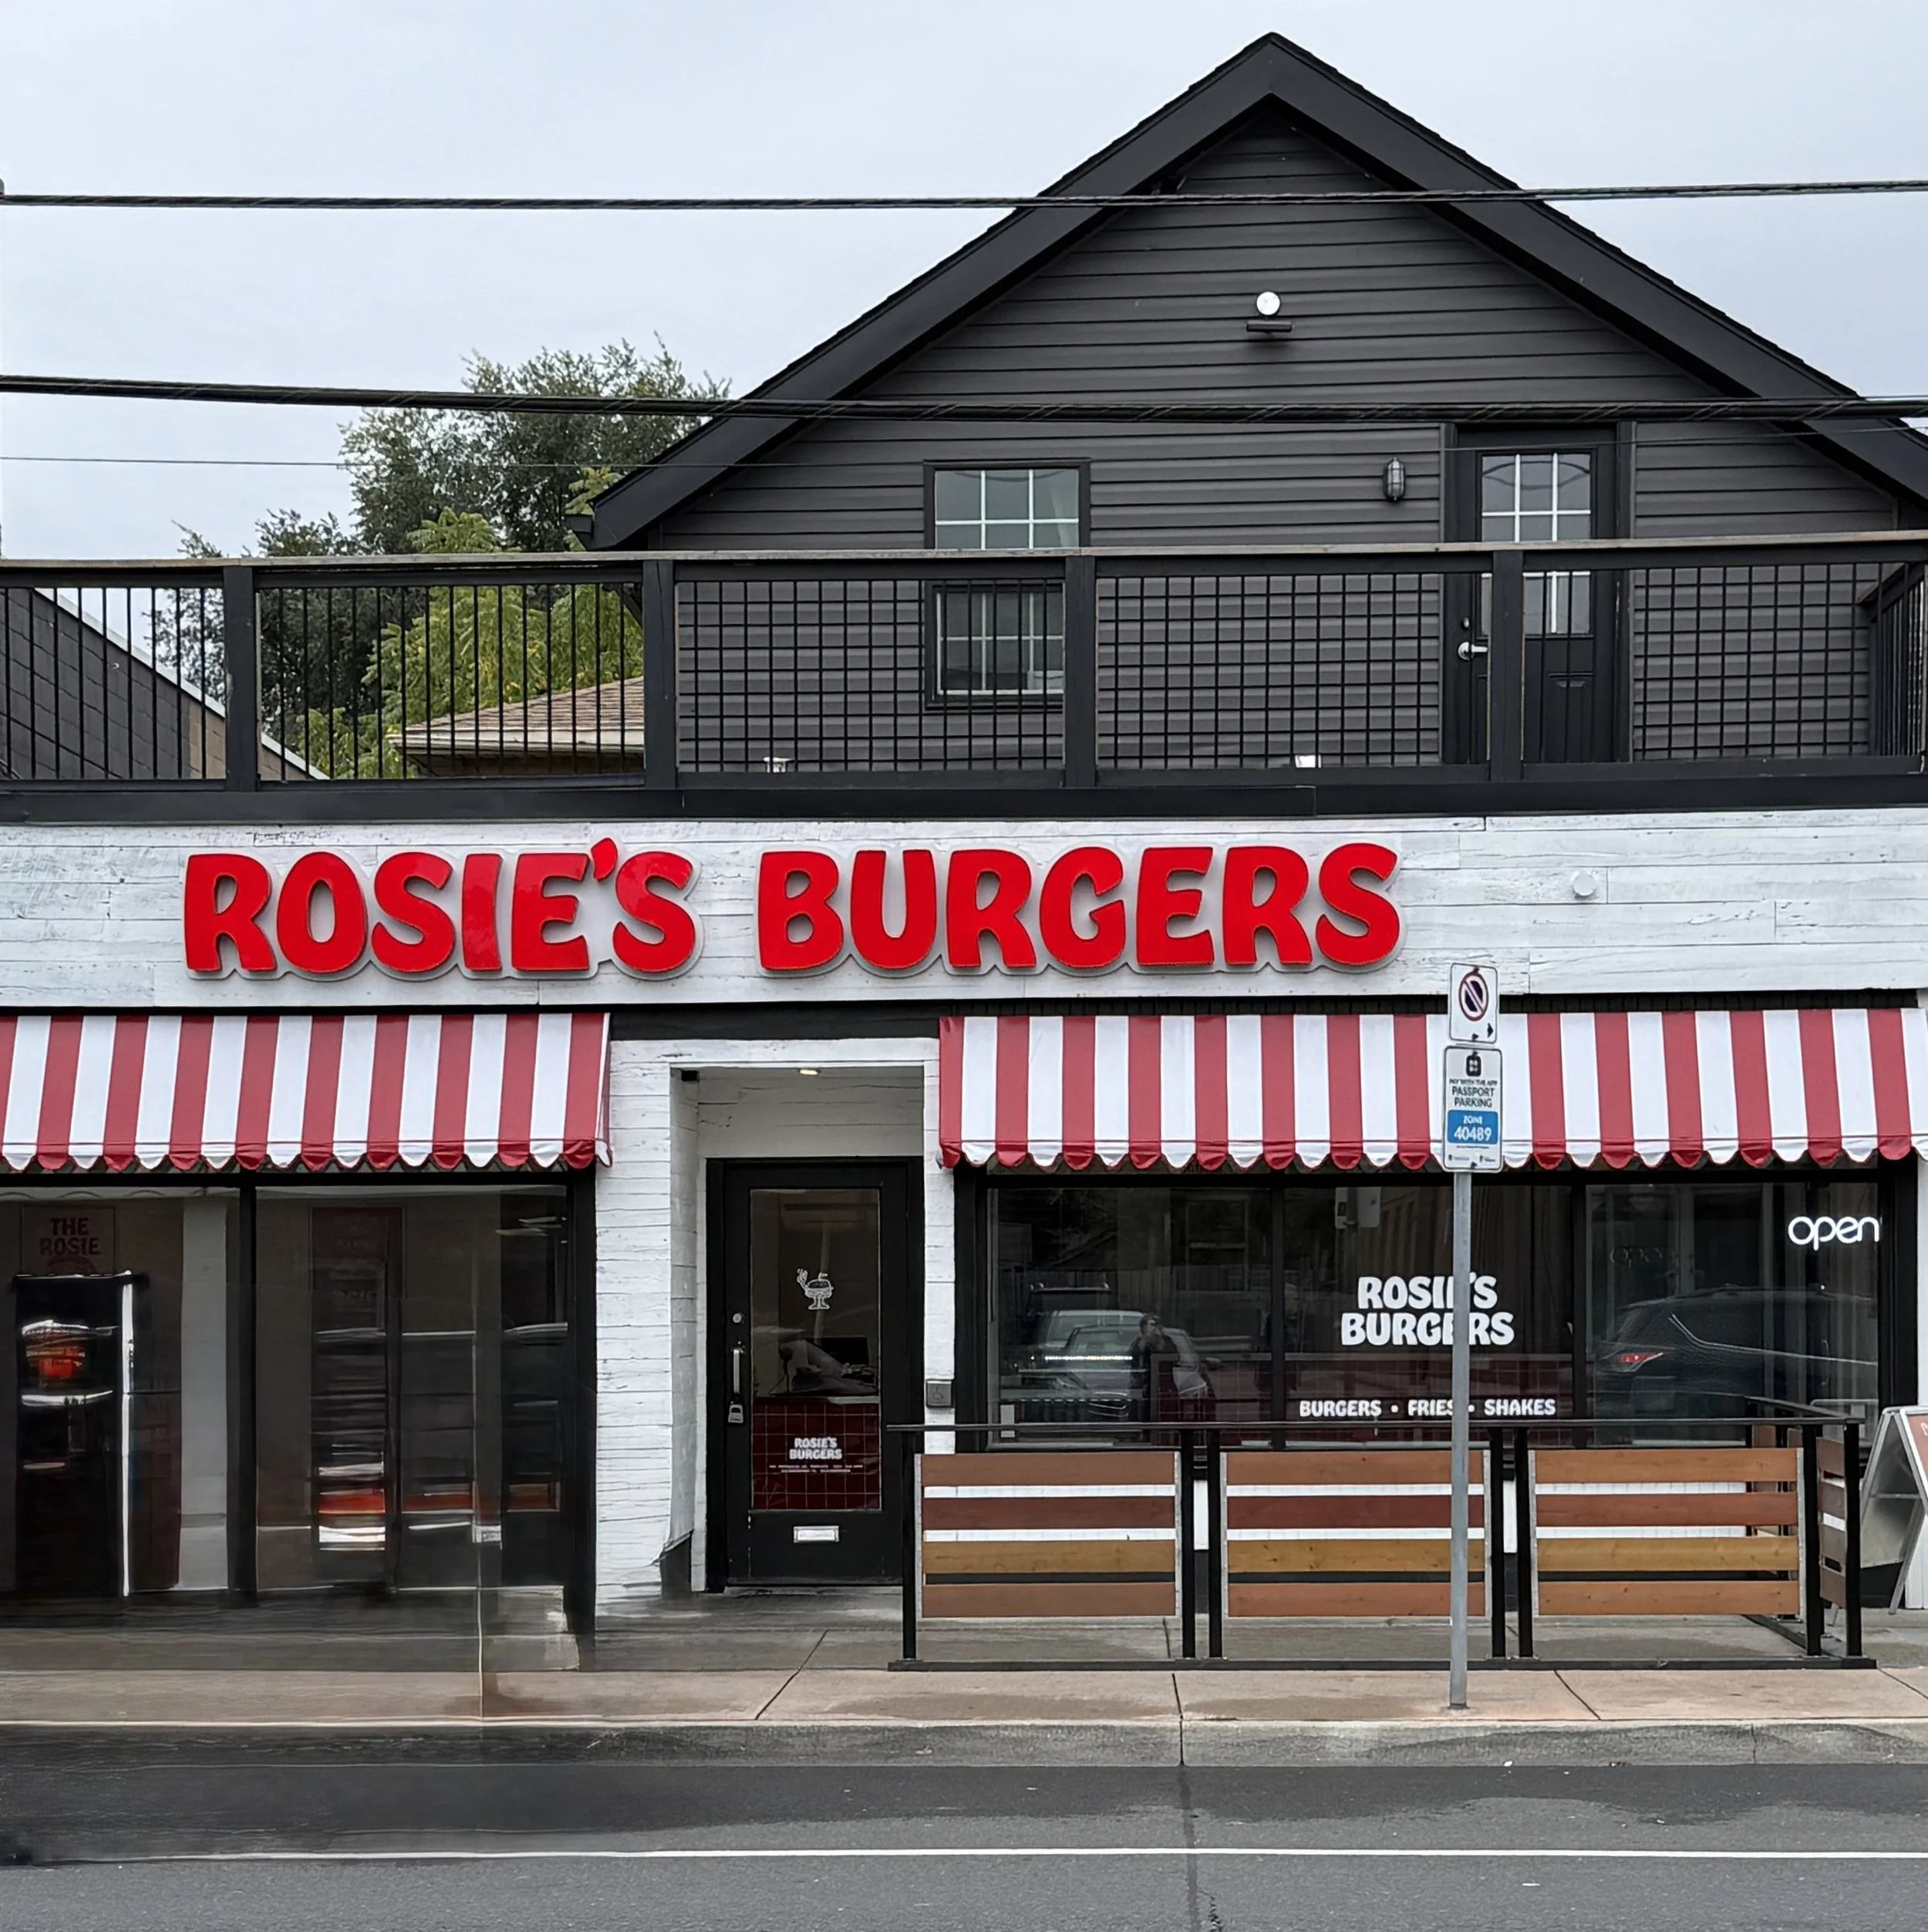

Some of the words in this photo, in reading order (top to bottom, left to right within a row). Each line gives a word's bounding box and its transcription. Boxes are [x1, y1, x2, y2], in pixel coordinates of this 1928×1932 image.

[184, 837, 696, 973] ROSIE'S
[757, 842, 1400, 970] BURGERS
[1452, 1086, 1495, 1097] PASSPORT
[1454, 1097, 1492, 1108] PARKING
[1454, 1126, 1492, 1141] 40489
[50, 1218, 89, 1236] THE
[1788, 1216, 1880, 1251] open
[40, 1238, 100, 1256] ROSIE
[1357, 1272, 1498, 1310] ROSI'S
[1299, 1399, 1382, 1418] BURGERS
[1485, 1398, 1556, 1417] SHAKES
[794, 1437, 838, 1448] ROSIE'S
[789, 1449, 843, 1460] BURGERS
